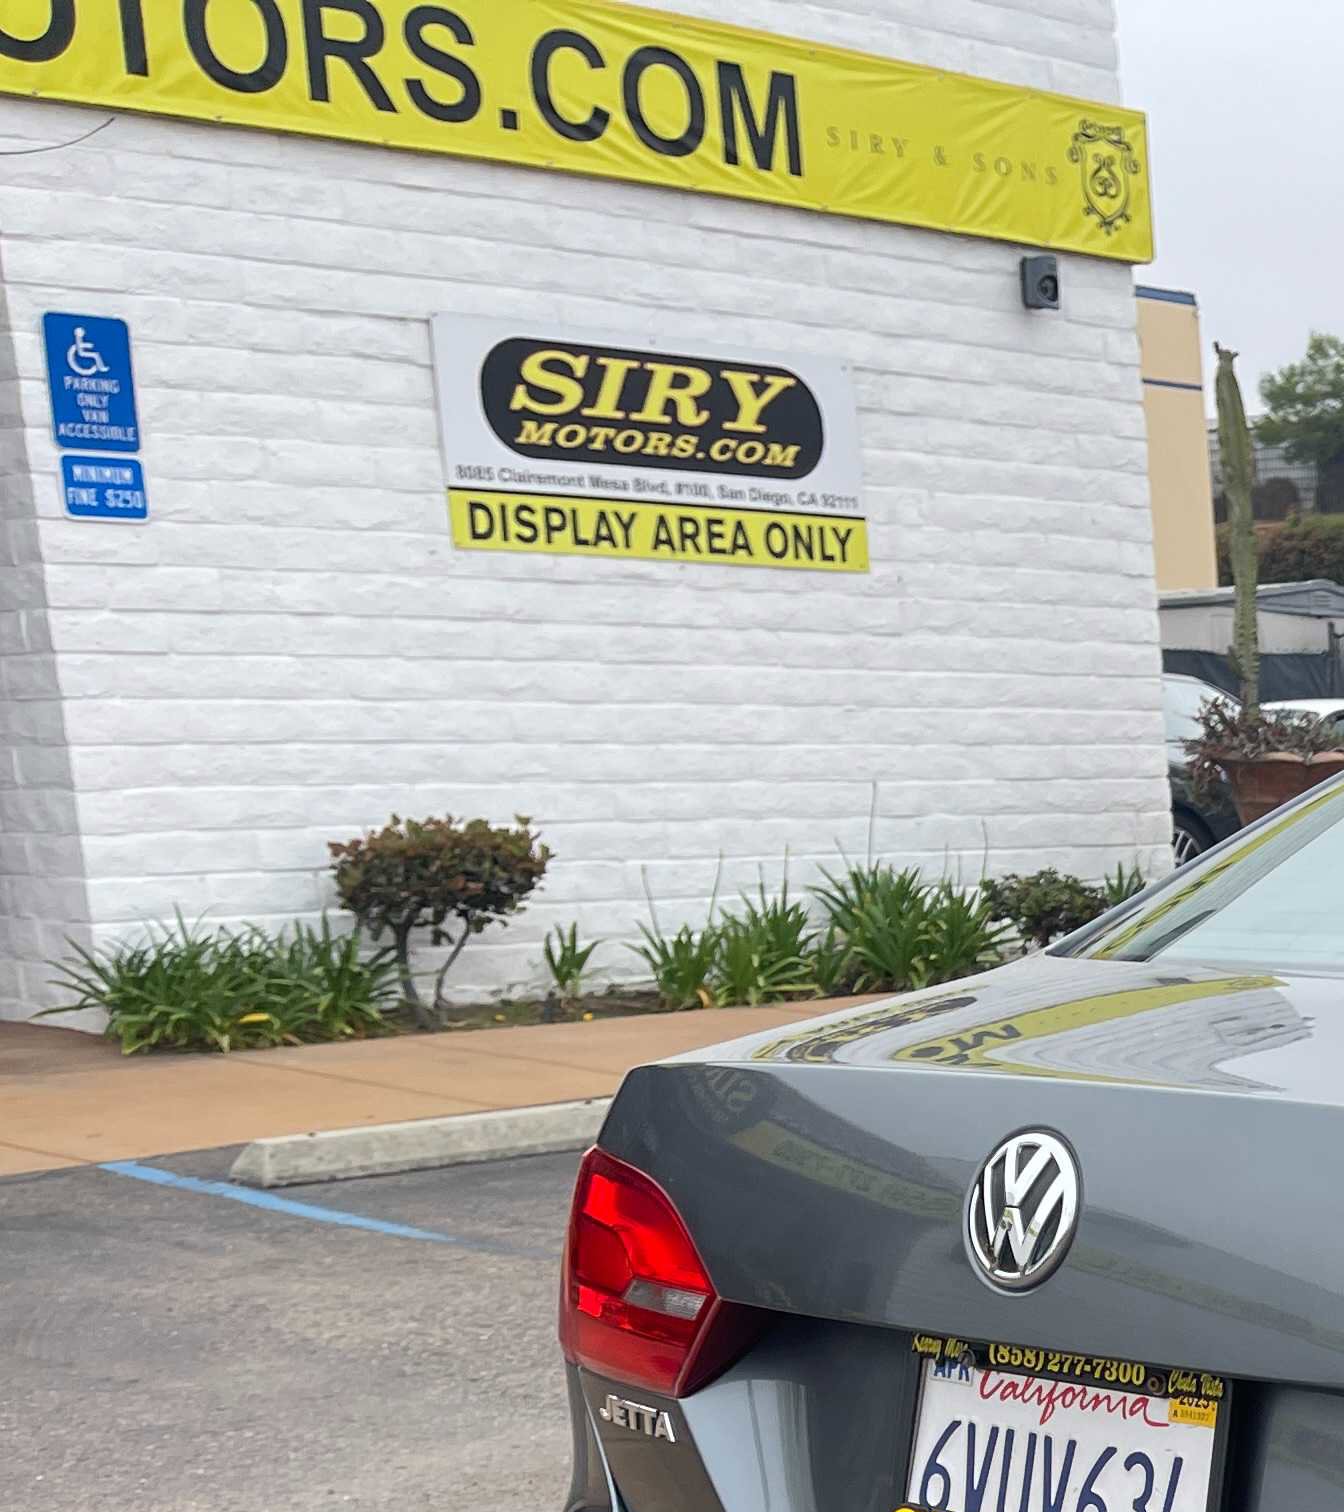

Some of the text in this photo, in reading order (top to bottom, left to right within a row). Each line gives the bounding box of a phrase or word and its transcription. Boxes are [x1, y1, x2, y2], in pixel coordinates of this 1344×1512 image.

[825, 126, 1057, 186] SIRY & SONS
[63, 375, 120, 393] PARKING
[76, 393, 110, 408] ONLY
[508, 349, 797, 434] SIRY
[58, 422, 137, 441] ACCESSIBLE
[81, 408, 110, 423] VAN
[515, 419, 802, 469] MOTORS.COM
[72, 464, 134, 485] MINIMUM
[67, 486, 145, 508] FINE $250
[468, 501, 854, 563] DISPLAY AREA ONLY
[976, 1368, 1170, 1428] California
[599, 1393, 676, 1443] JETTA
